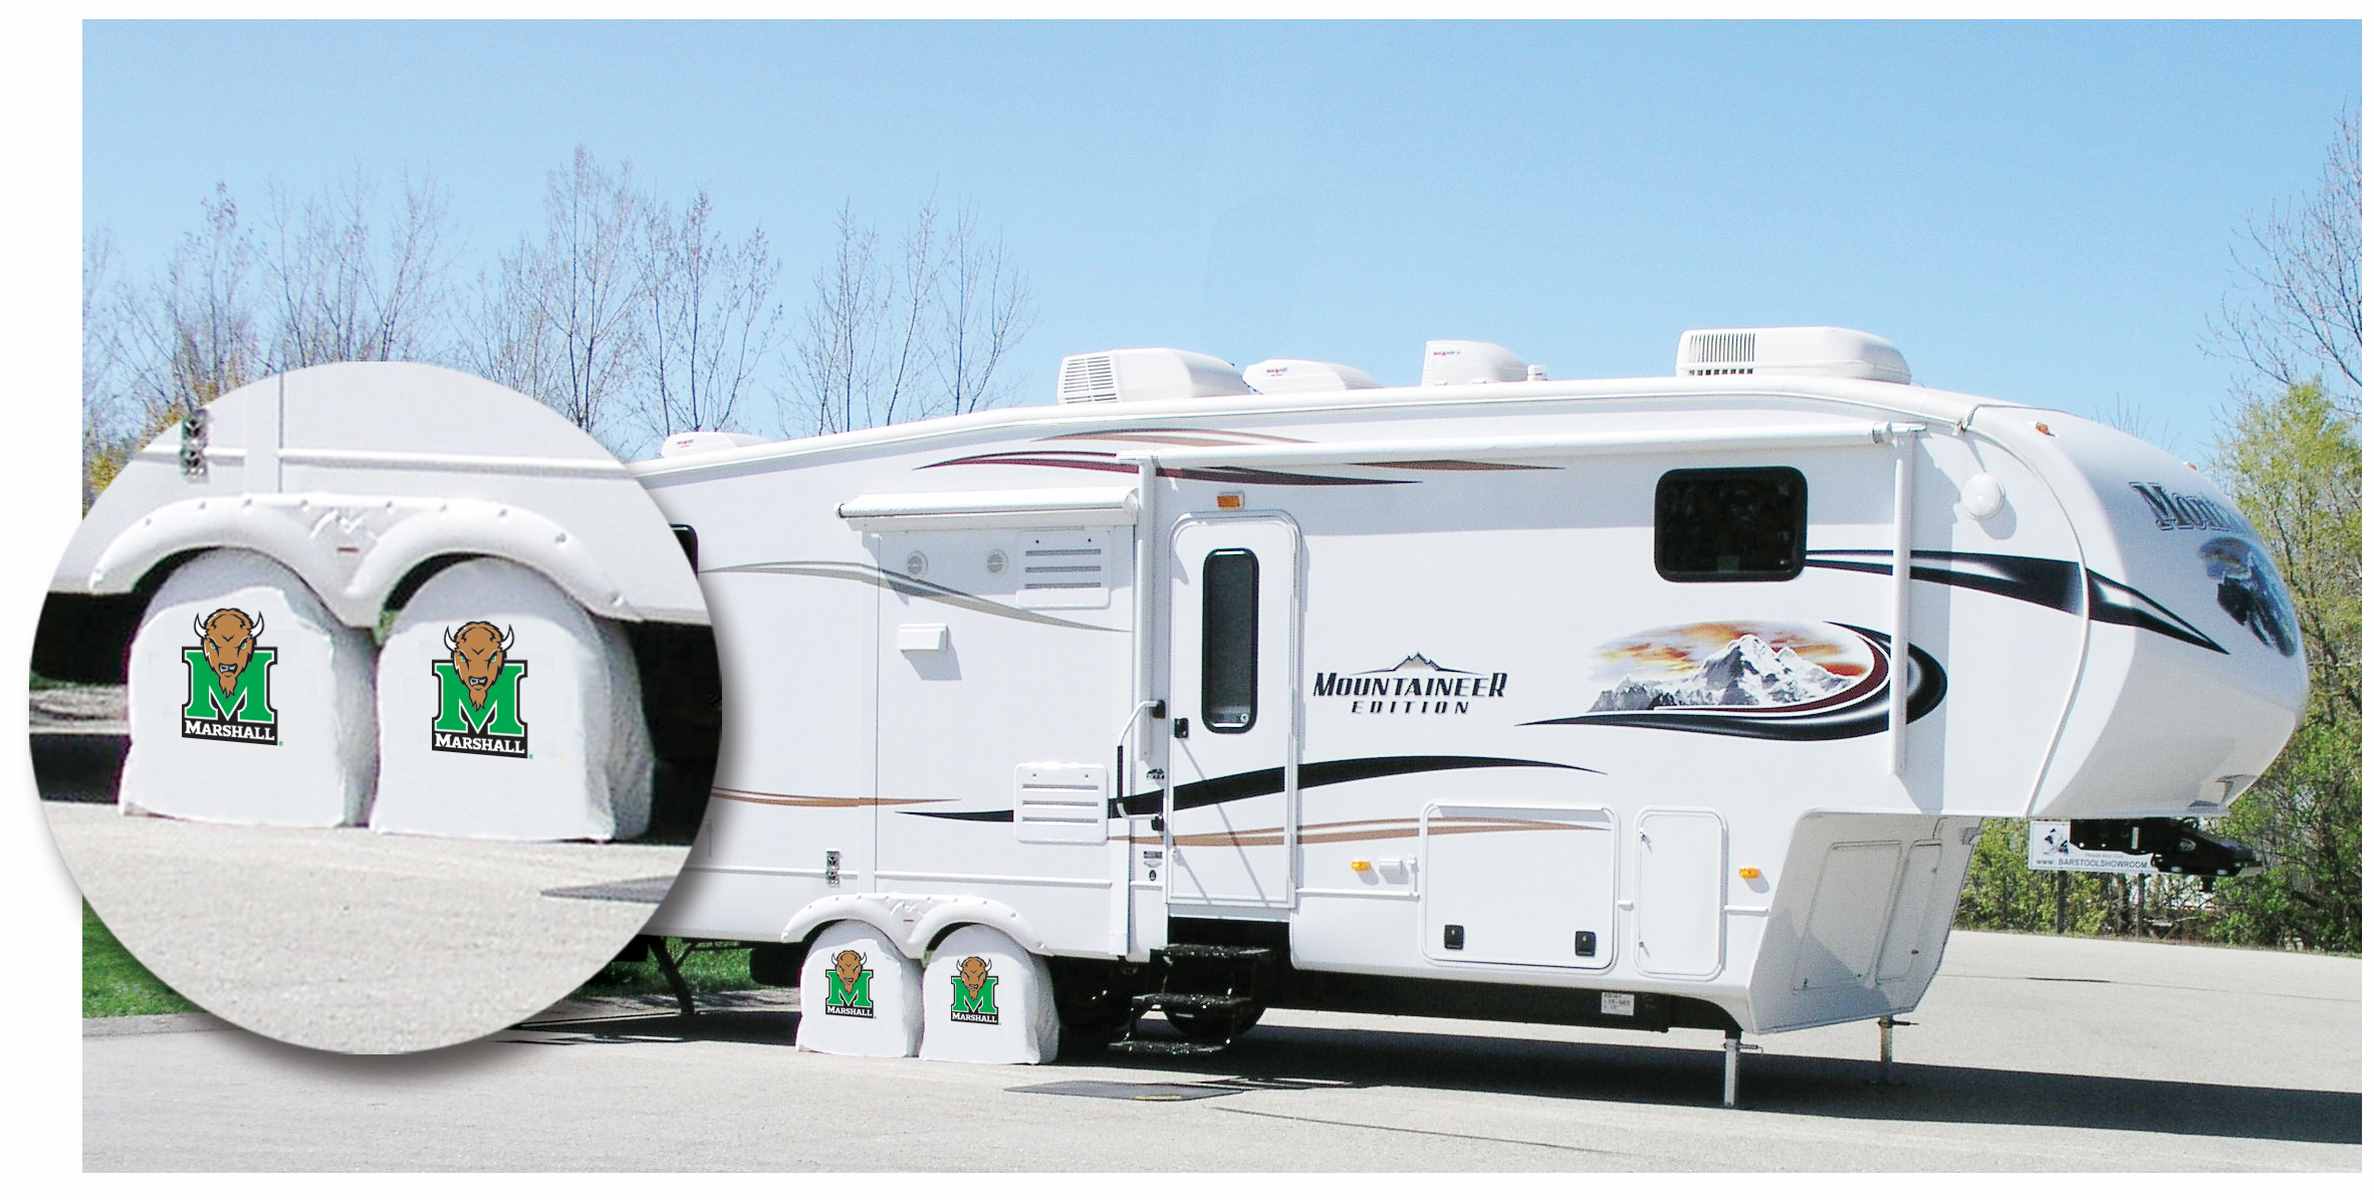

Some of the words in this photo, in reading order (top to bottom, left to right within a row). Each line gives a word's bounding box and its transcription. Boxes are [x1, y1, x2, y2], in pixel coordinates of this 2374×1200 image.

[1313, 672, 1508, 697] MOUNTAINEER
[1351, 701, 1469, 715] EDITION
[184, 720, 275, 741] MARSHALL
[434, 733, 525, 754] MARSHALL
[827, 1005, 873, 1017] MARSHALL
[952, 1012, 998, 1024] MARSHALL
